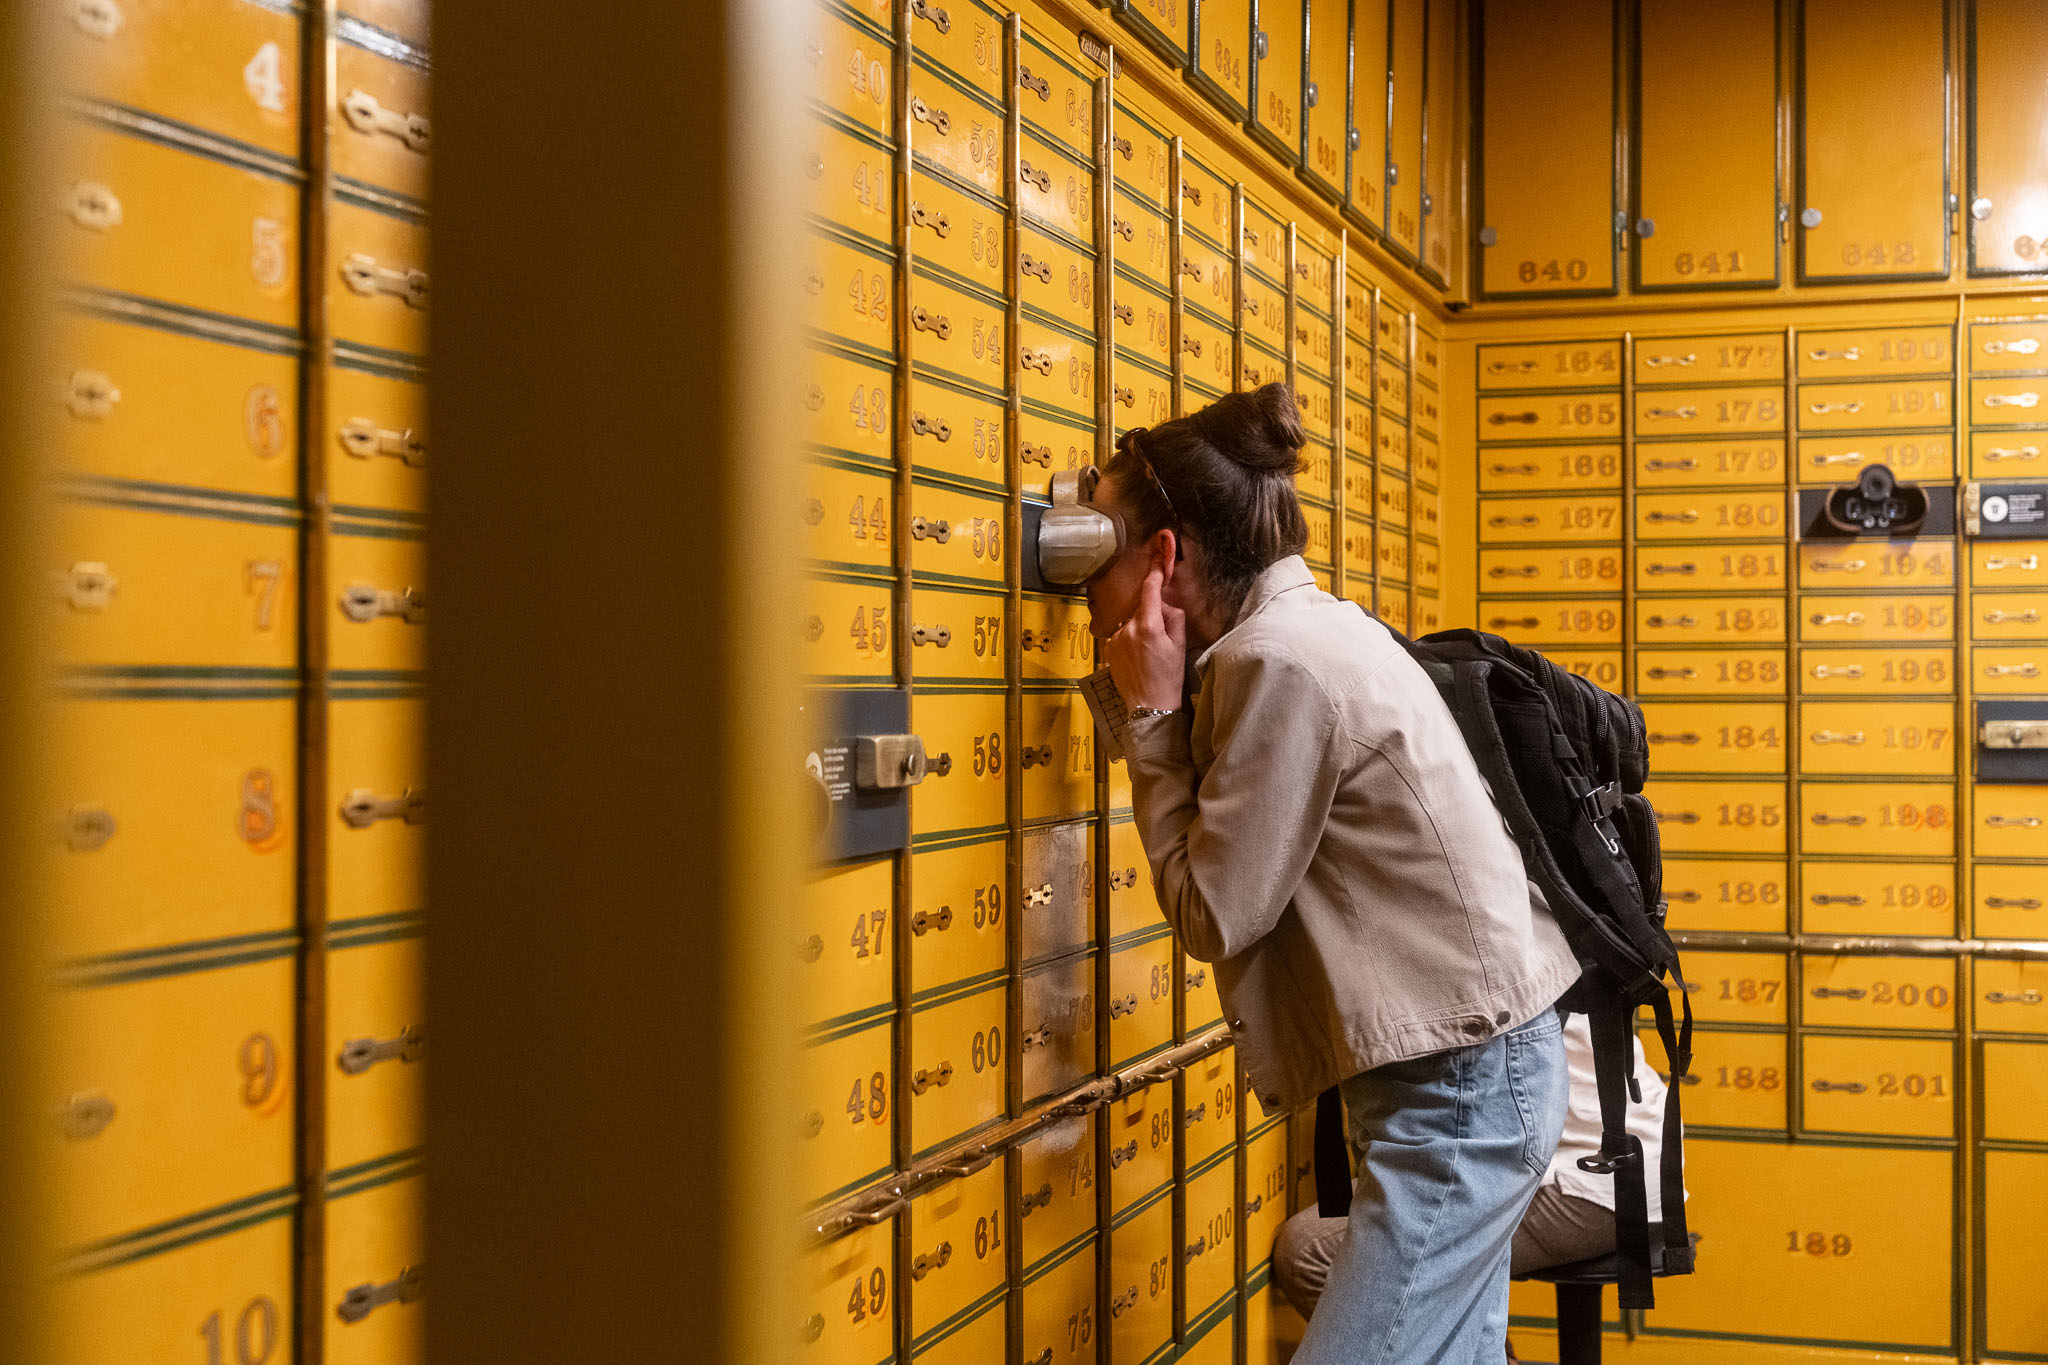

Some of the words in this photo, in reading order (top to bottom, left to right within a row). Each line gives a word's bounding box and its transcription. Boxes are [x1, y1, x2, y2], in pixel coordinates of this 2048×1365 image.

[974, 23, 998, 75] 51
[243, 42, 284, 113] 4
[848, 49, 886, 104] 40
[1066, 89, 1089, 136] 64
[970, 120, 999, 171] 52
[1147, 144, 1167, 188] 76
[852, 161, 886, 214] 41
[1067, 176, 1089, 221] 65
[250, 219, 287, 288] 5
[972, 219, 999, 268] 53
[1147, 227, 1166, 269] 77
[1265, 230, 1283, 268] 101
[1841, 241, 1915, 266] 642
[1518, 260, 1588, 283] 640
[1675, 251, 1743, 275] 641
[849, 269, 887, 321] 42
[1068, 264, 1090, 309] 66
[1147, 307, 1168, 346] 78
[1264, 299, 1283, 335] 102
[972, 317, 1001, 365] 54
[1313, 330, 1329, 362] 115
[1717, 344, 1778, 369] 177
[1879, 337, 1945, 362] 190
[1068, 356, 1091, 398] 67
[1555, 350, 1616, 373] 164
[850, 384, 886, 433] 43
[1557, 403, 1616, 425] 165
[1716, 399, 1777, 423] 178
[1887, 389, 1946, 414] 191
[242, 384, 284, 458] 6
[973, 417, 1000, 463] 55
[1314, 457, 1330, 485] 117
[1558, 454, 1617, 477] 166
[1715, 447, 1778, 473] 179
[850, 495, 886, 541] 44
[1559, 506, 1616, 529] 167
[1716, 503, 1778, 526] 180
[972, 517, 1000, 561] 56
[1313, 521, 1330, 549] 118
[1558, 557, 1618, 579] 168
[1720, 554, 1778, 577] 181
[1879, 553, 1945, 576] 194
[244, 559, 284, 630] 7
[850, 606, 887, 652] 45
[1558, 608, 1616, 632] 169
[1715, 607, 1779, 631] 182
[1883, 605, 1948, 628] 195
[974, 616, 1000, 657] 57
[1068, 622, 1090, 660] 70
[1563, 662, 1617, 683] 70
[1716, 660, 1779, 683] 183
[1881, 659, 1948, 684] 196
[973, 732, 1001, 777] 58
[1070, 736, 1092, 772] 71
[1718, 726, 1781, 749] 184
[1883, 727, 1949, 750] 197
[240, 767, 276, 844] 8
[1717, 803, 1780, 828] 185
[1880, 804, 1948, 828] 198
[1069, 861, 1092, 901] 72
[1718, 881, 1781, 905] 186
[1882, 885, 1948, 908] 199
[974, 884, 1001, 929] 59
[850, 909, 887, 959] 47
[1150, 963, 1170, 1001] 85
[1719, 979, 1781, 1002] 187
[1872, 982, 1949, 1008] 200
[1071, 994, 1092, 1037] 73
[972, 1026, 1001, 1073] 60
[239, 1031, 277, 1109] 9
[1717, 1067, 1781, 1090] 188
[1878, 1074, 1947, 1098] 201
[847, 1071, 886, 1124] 48
[1215, 1083, 1233, 1121] 99
[1151, 1107, 1170, 1149] 86
[1068, 1152, 1092, 1197] 74
[1266, 1163, 1284, 1202] 112
[974, 1210, 1001, 1260] 61
[1208, 1208, 1233, 1250] 100
[1786, 1231, 1852, 1257] 189
[848, 1267, 886, 1324] 49
[1150, 1255, 1169, 1298] 87
[199, 1296, 280, 1365] 10
[1067, 1304, 1092, 1353] 75
